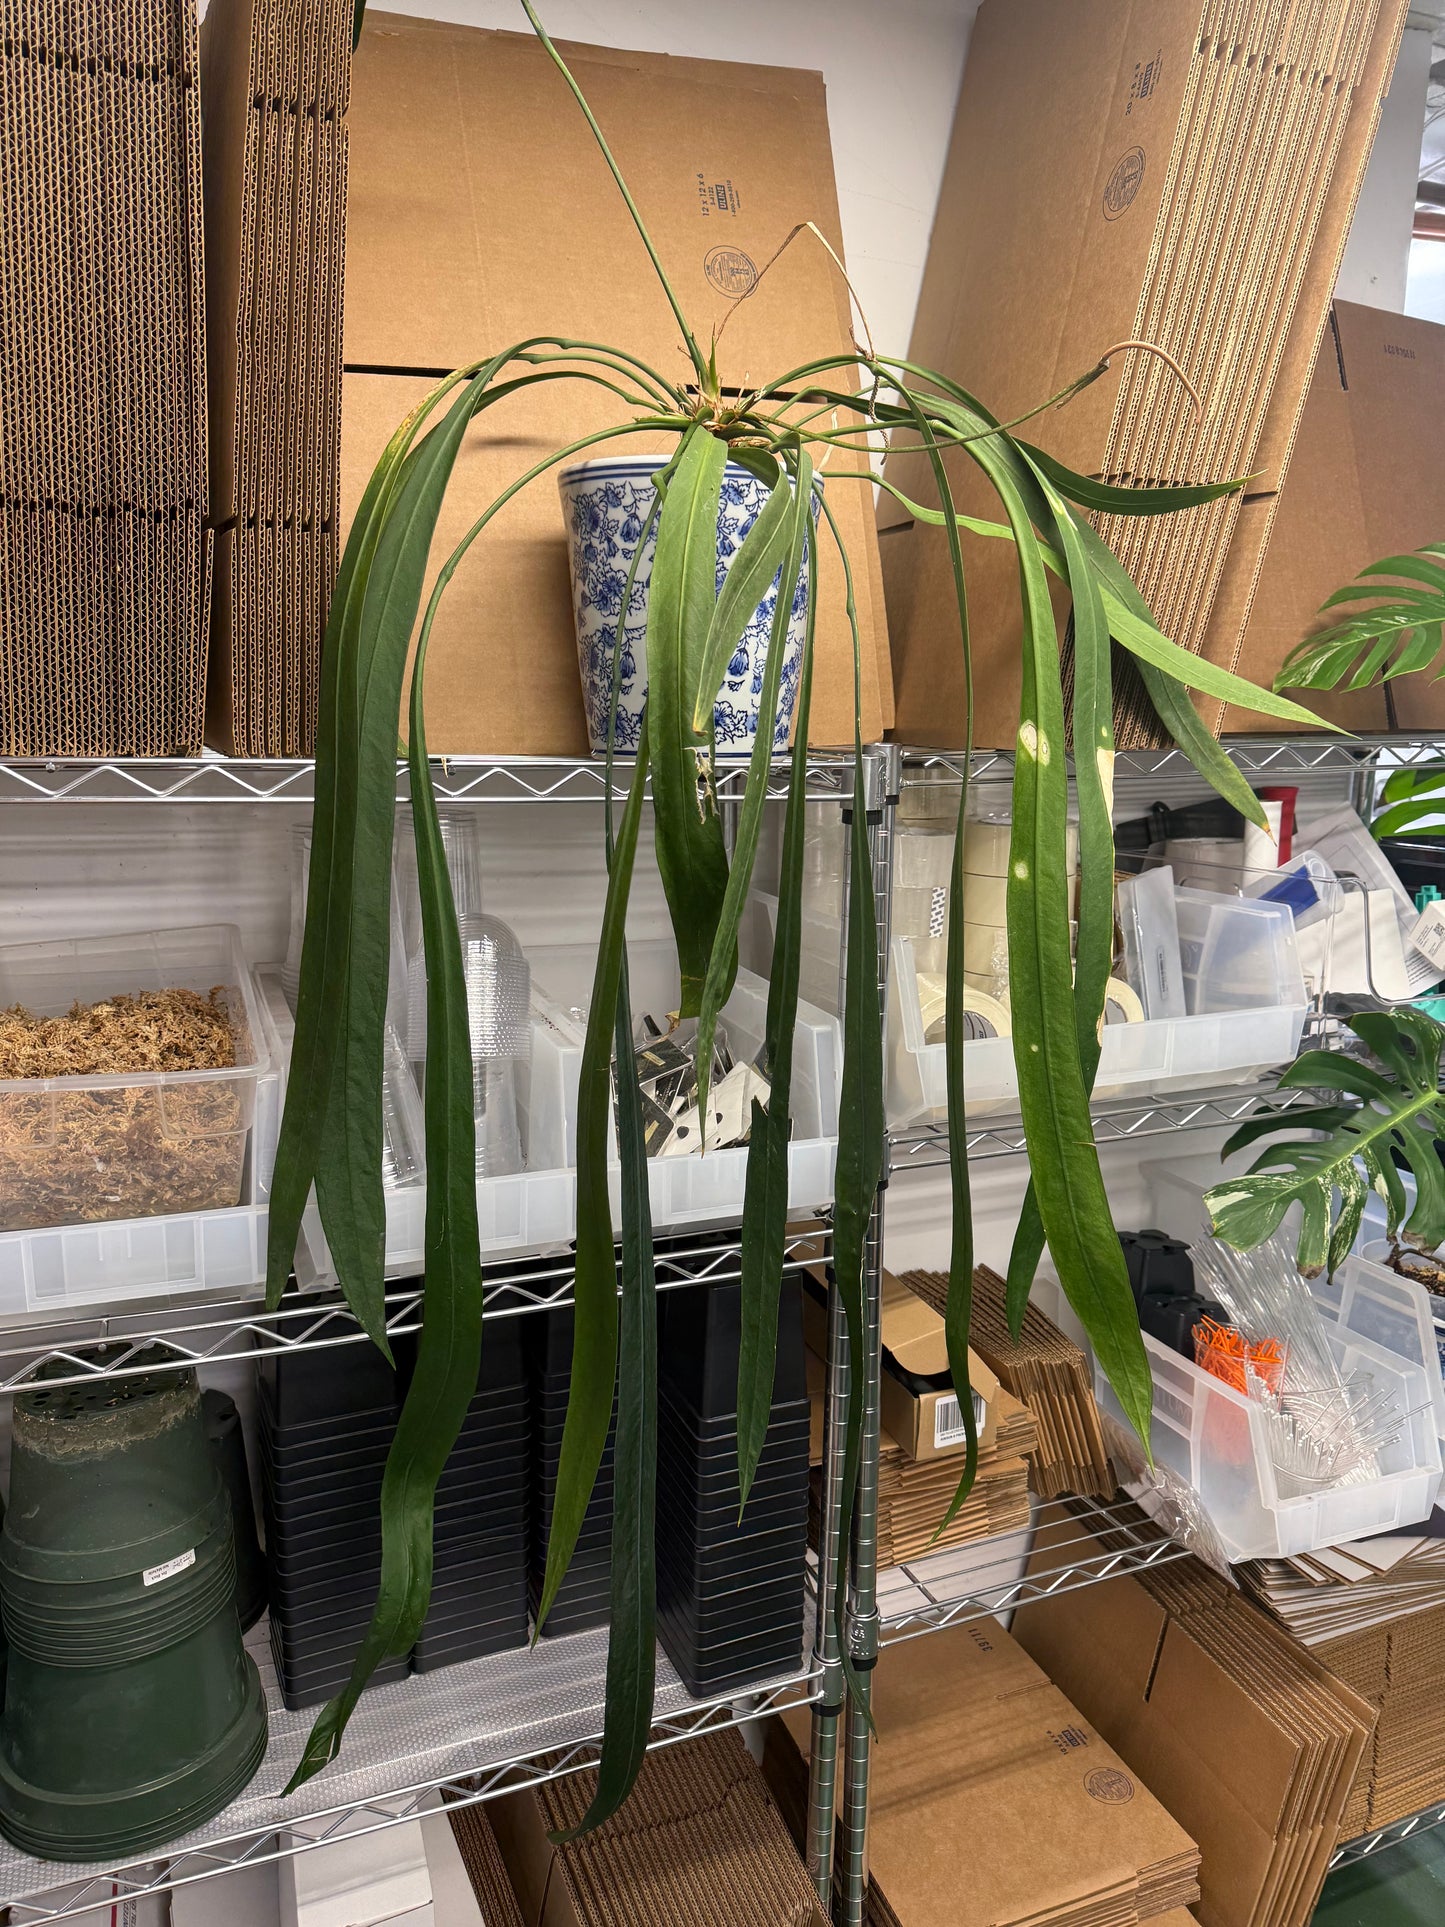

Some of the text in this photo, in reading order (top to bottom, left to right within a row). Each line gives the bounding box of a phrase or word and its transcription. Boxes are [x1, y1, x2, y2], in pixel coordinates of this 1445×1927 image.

[699, 187, 707, 197] 12
[715, 184, 728, 210] ULINE
[702, 206, 710, 217] 12
